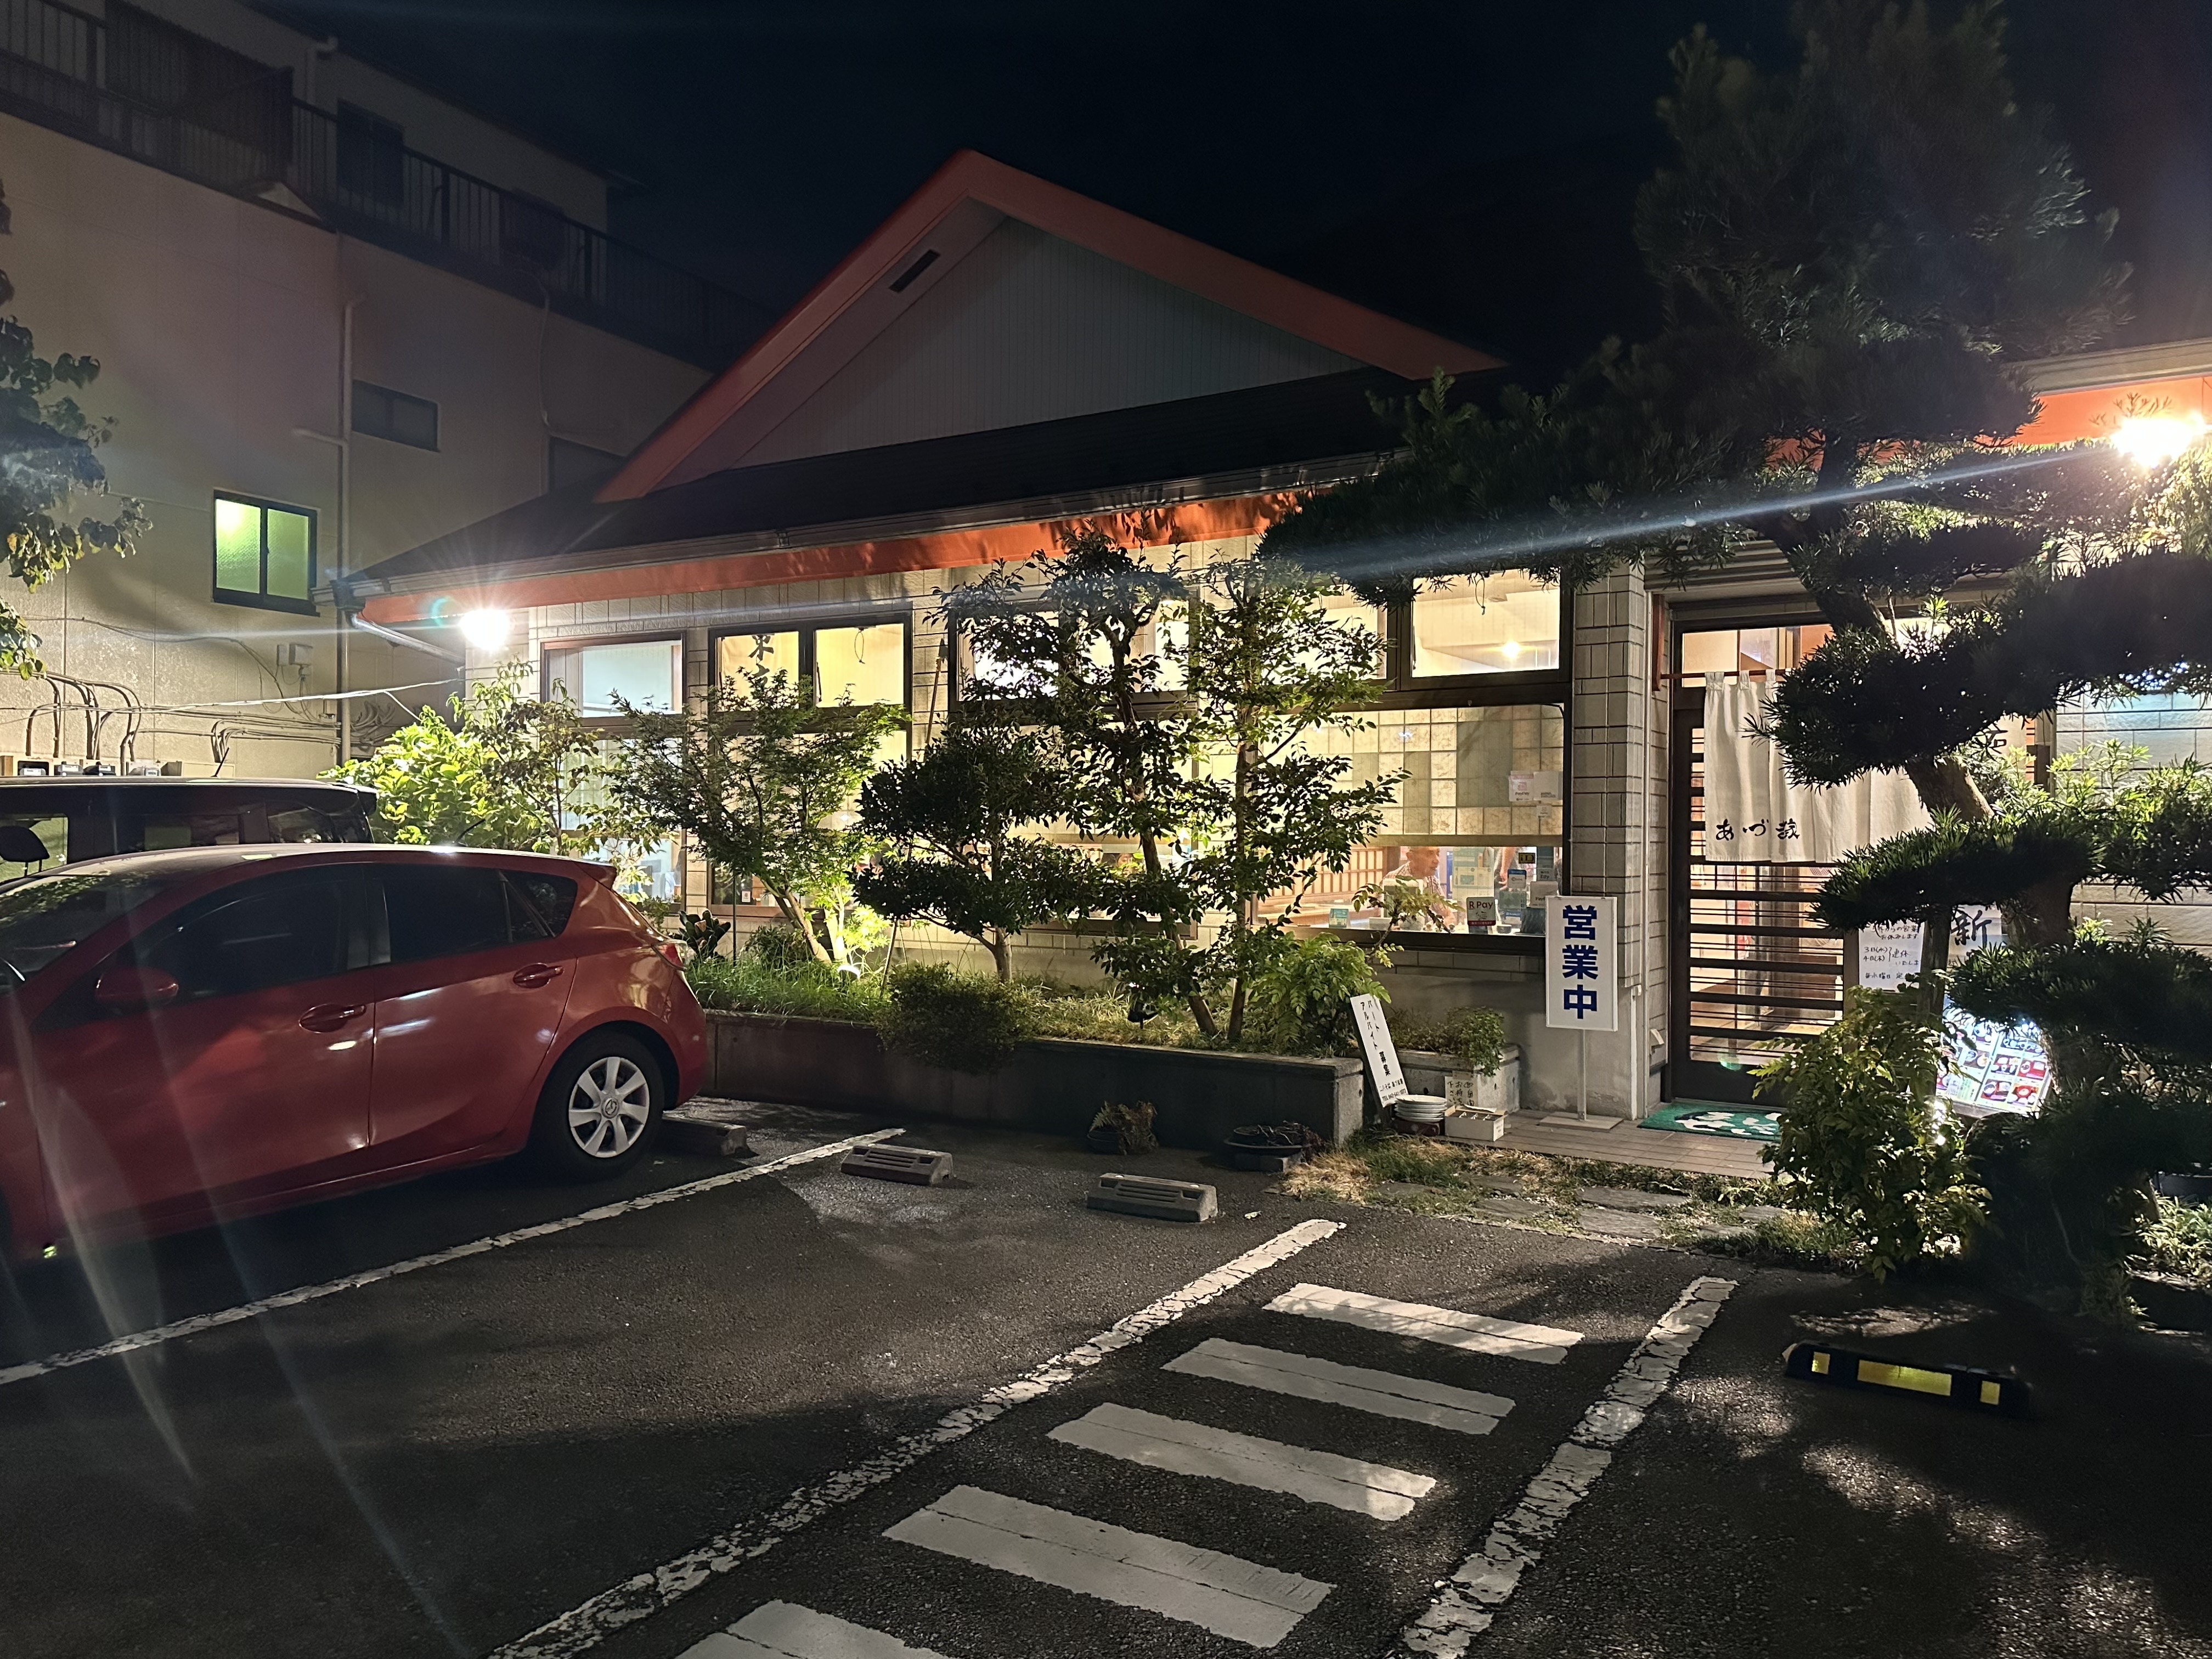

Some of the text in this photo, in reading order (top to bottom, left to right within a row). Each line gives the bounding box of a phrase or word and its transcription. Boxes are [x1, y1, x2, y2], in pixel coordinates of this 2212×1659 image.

[1476, 901, 1493, 910] Pay
[1562, 905, 1599, 1020] 営業中
